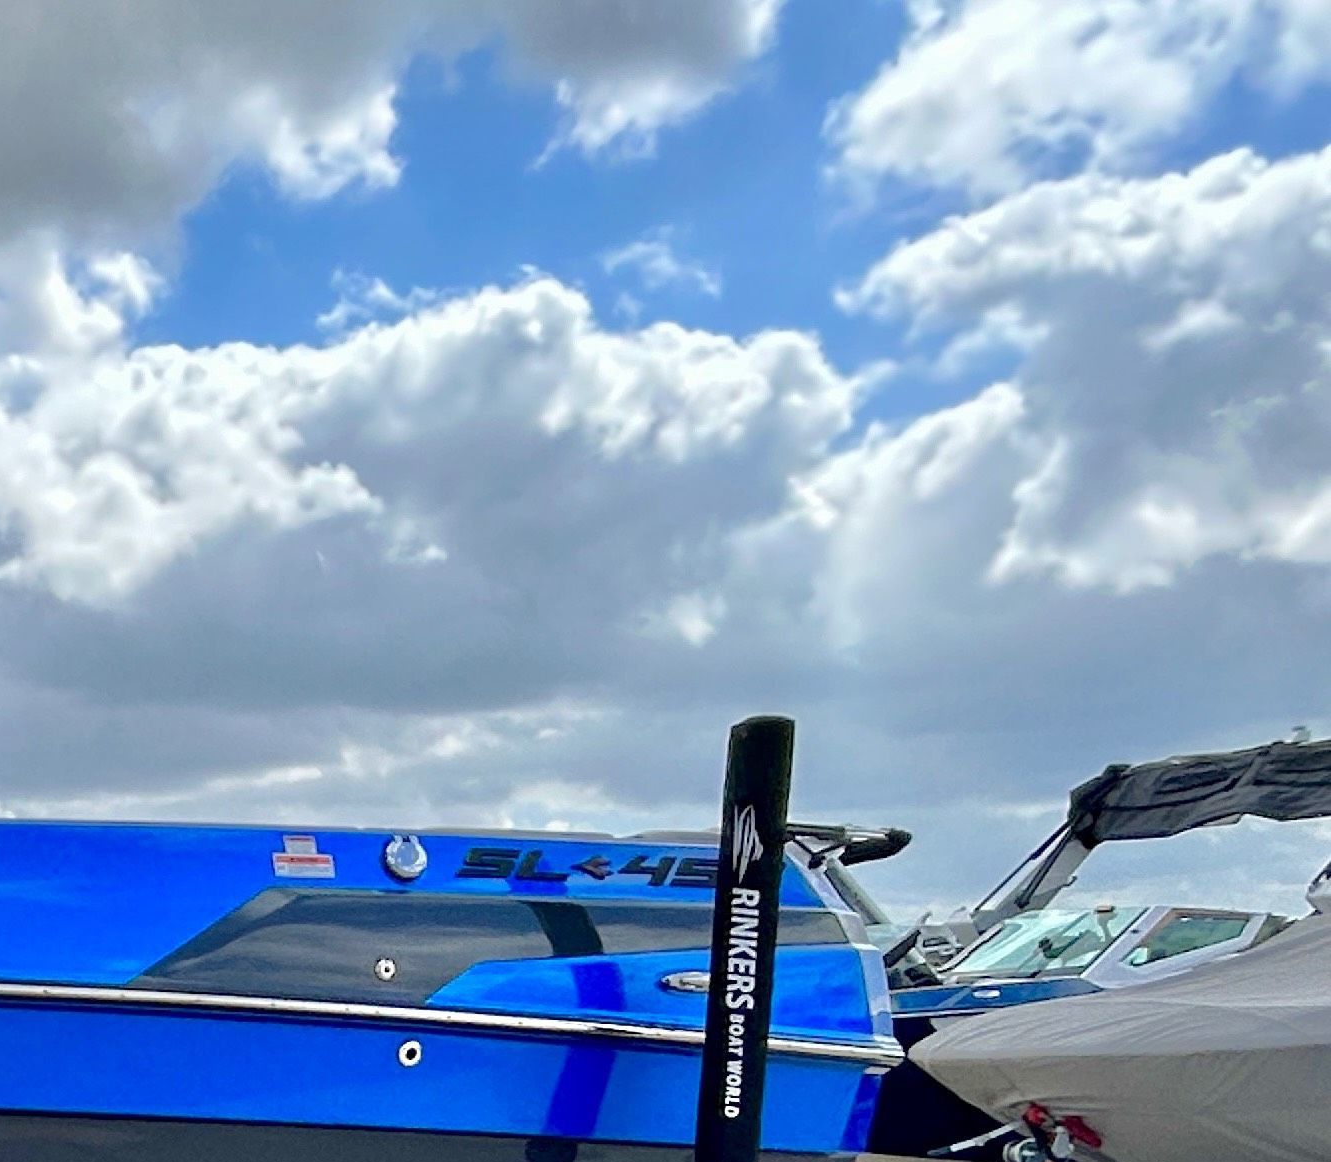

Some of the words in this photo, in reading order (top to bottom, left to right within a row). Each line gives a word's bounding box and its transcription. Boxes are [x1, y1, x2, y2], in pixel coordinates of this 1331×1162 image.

[455, 847, 568, 882] SL
[618, 855, 719, 887] 45
[725, 887, 760, 1010] RINKERS
[728, 1013, 745, 1061] BOAT
[724, 1063, 744, 1118] WORLD
